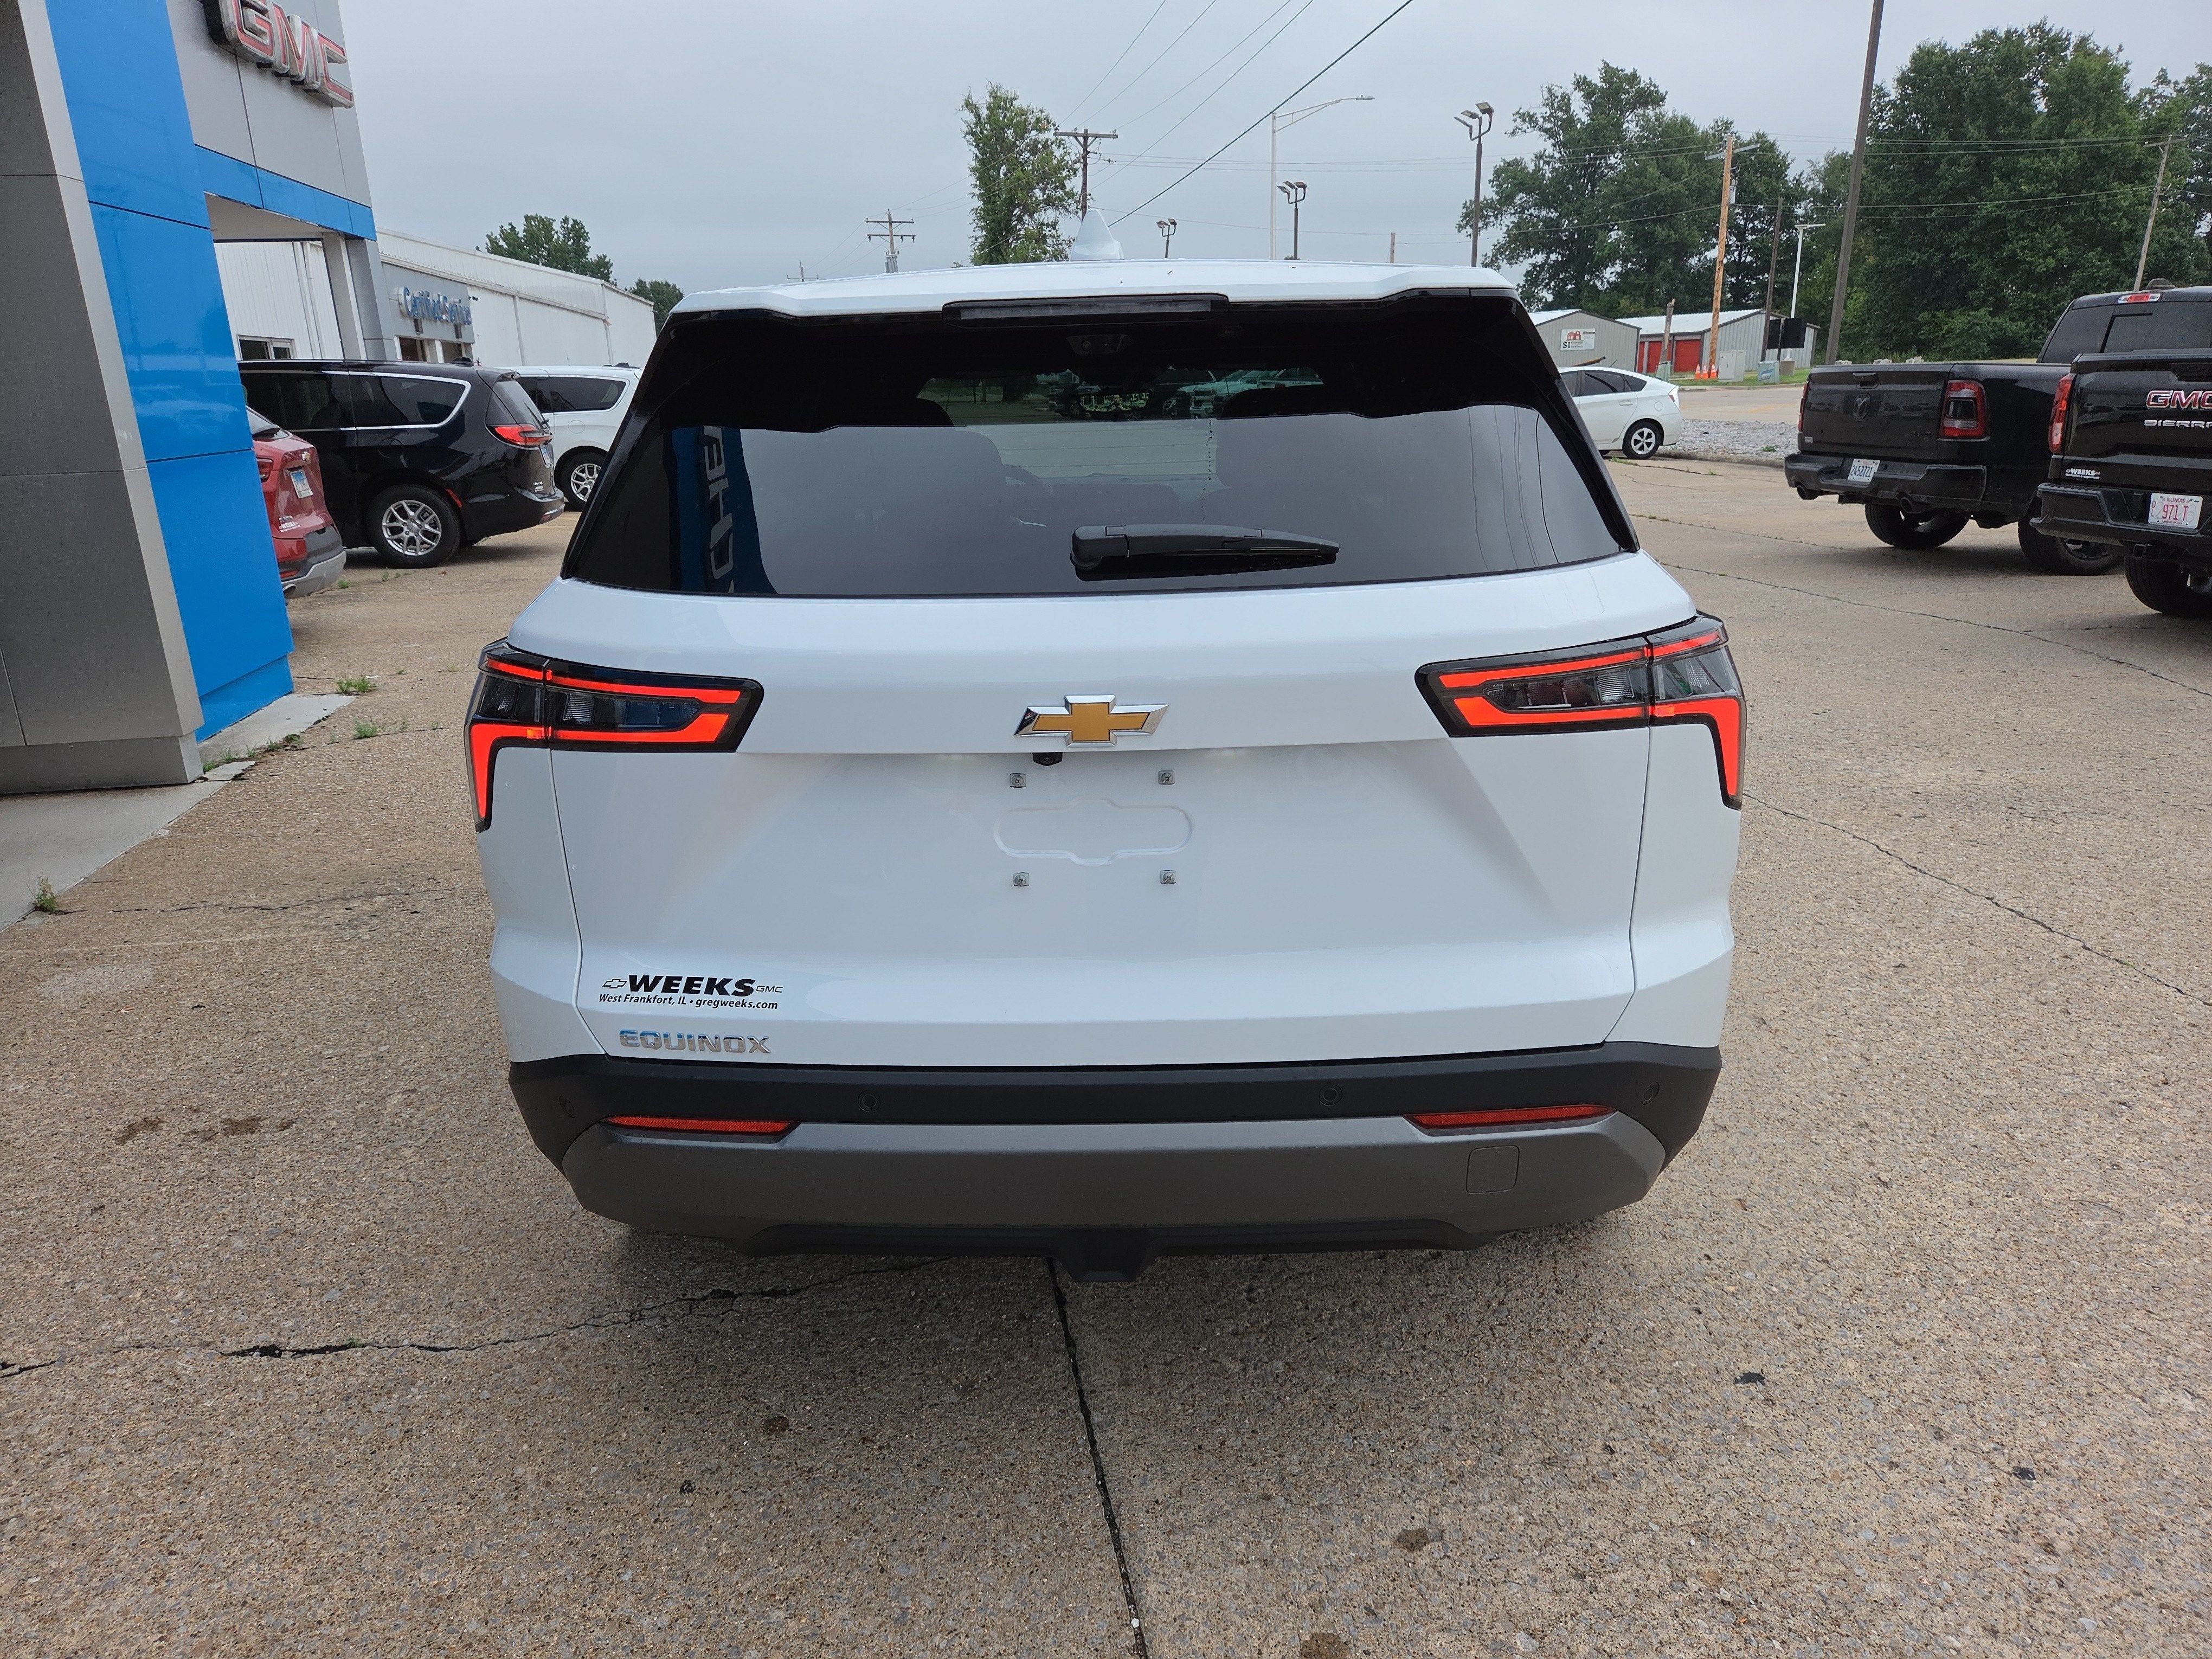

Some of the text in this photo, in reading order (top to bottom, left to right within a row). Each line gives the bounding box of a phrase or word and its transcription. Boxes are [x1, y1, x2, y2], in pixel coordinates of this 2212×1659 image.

[209, 0, 355, 108] GMC
[2162, 504, 2189, 521] 971 T
[628, 974, 783, 997] WEEKS GMC
[599, 994, 779, 1009] West Frankfort, IL gregweeks.com
[619, 1029, 771, 1053] EQUINOX
